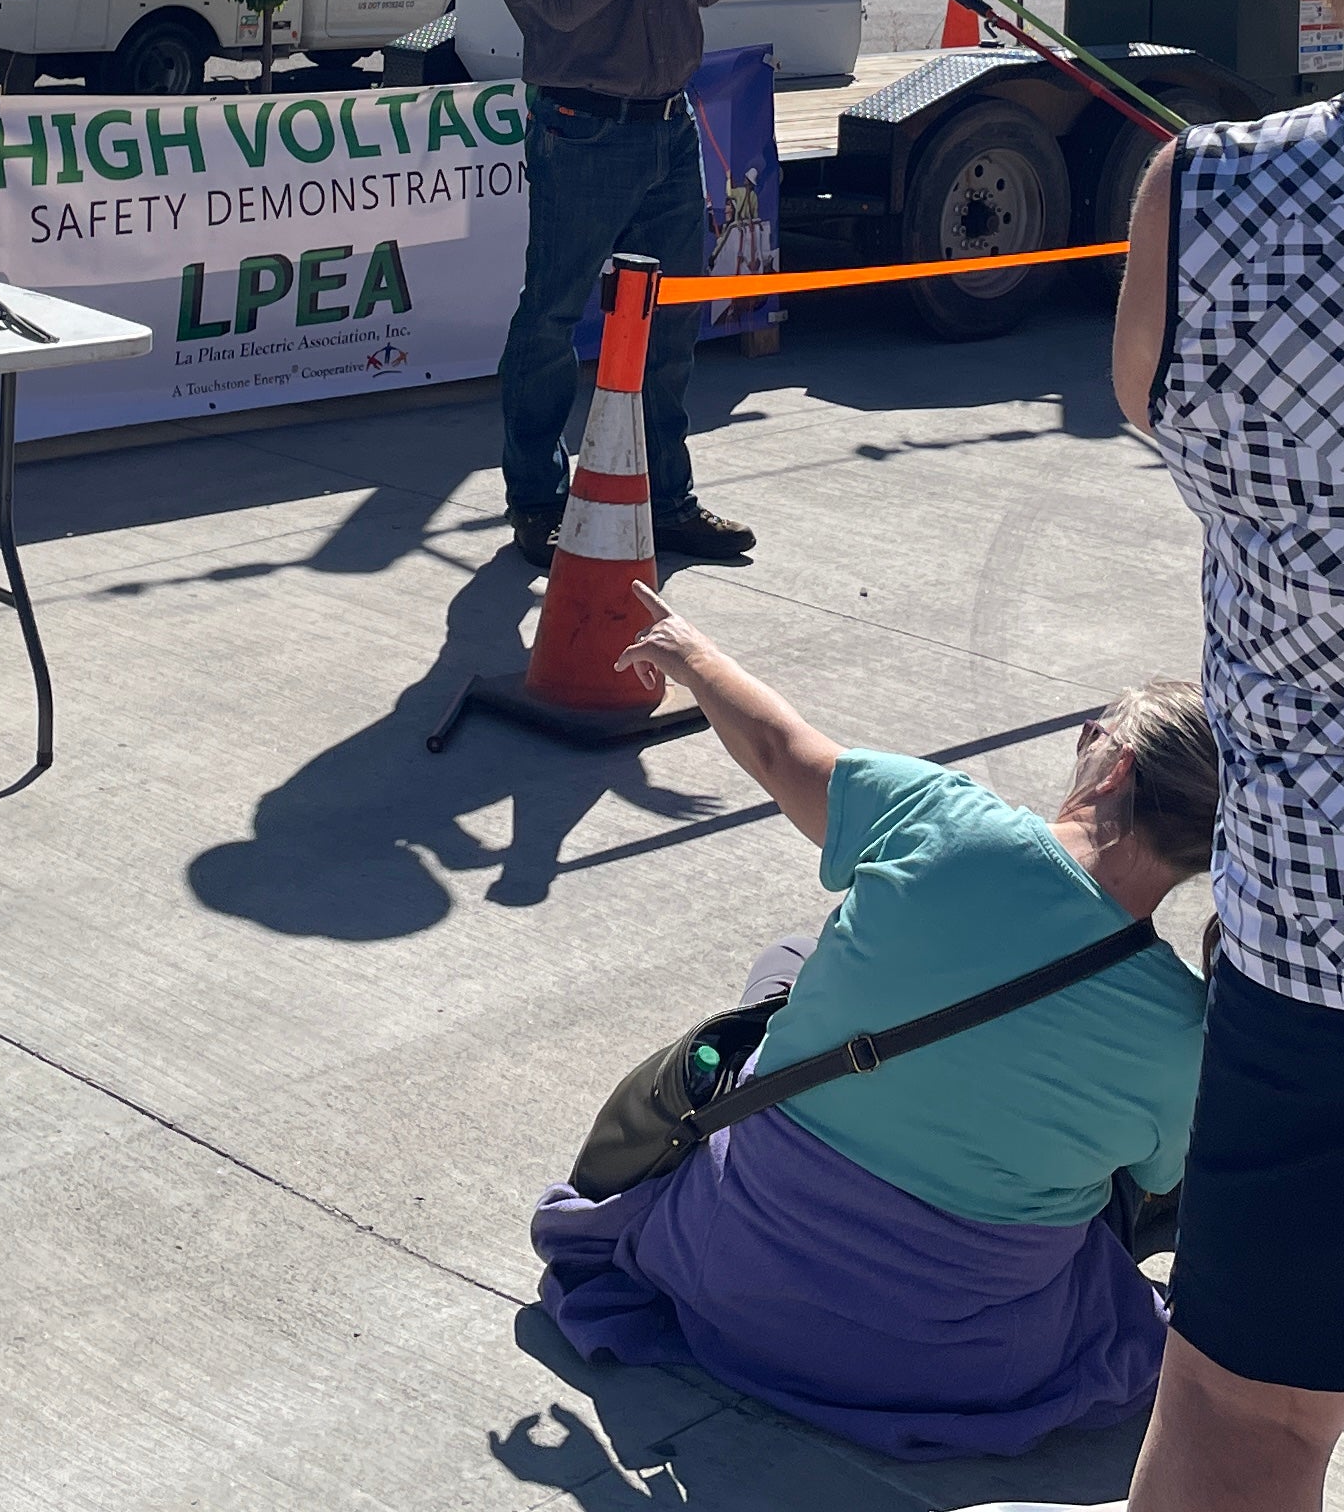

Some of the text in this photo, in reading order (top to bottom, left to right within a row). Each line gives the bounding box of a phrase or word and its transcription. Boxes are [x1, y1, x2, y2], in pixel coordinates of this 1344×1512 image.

[31, 193, 186, 243] SAFETY
[176, 240, 413, 342] LPEA
[175, 324, 411, 366] La Plata Electric Association, Inc.
[171, 385, 183, 398] A
[186, 377, 250, 397] Touchstone
[301, 362, 365, 380] Cooperative
